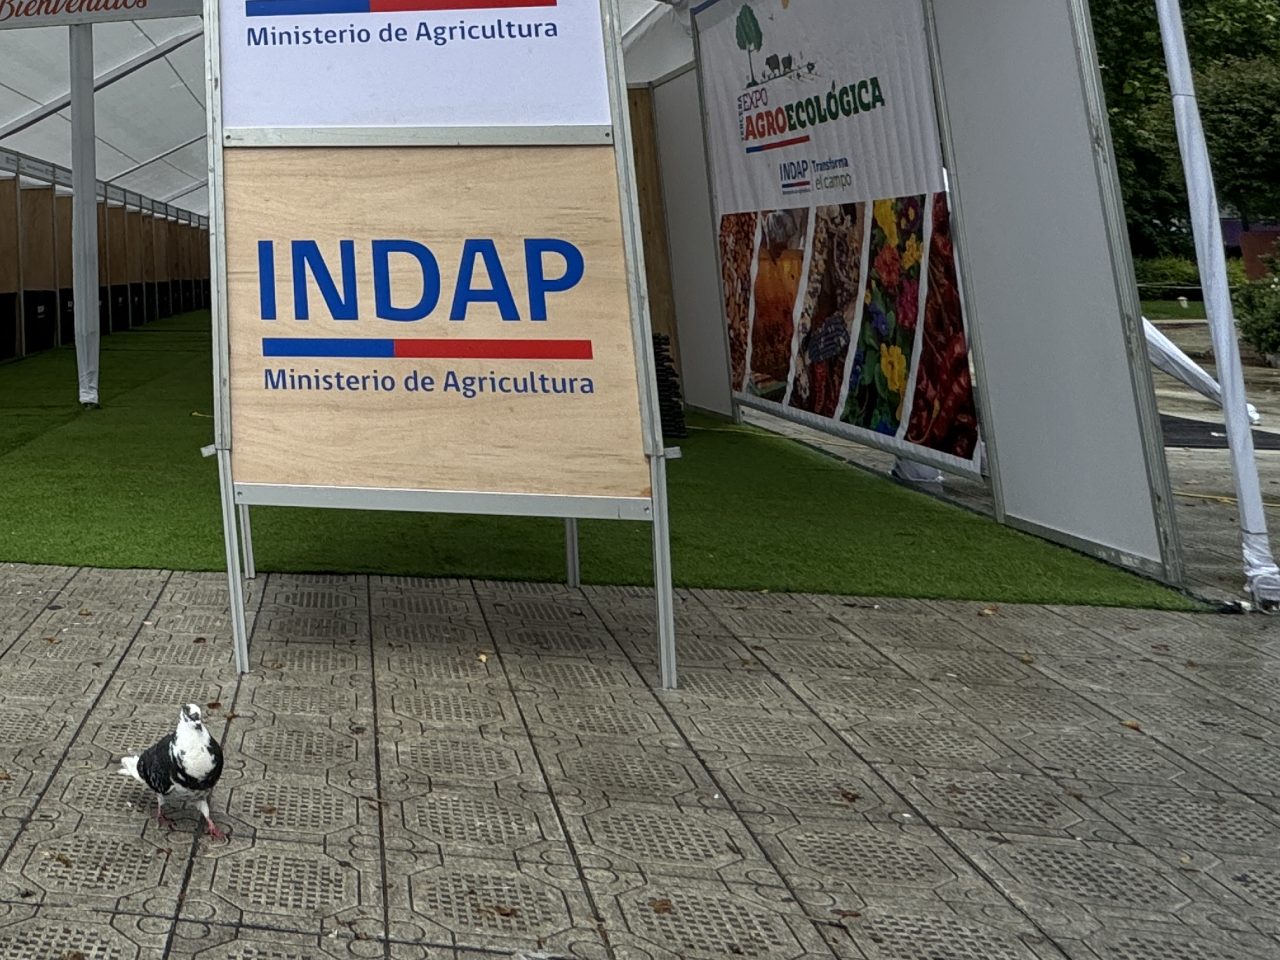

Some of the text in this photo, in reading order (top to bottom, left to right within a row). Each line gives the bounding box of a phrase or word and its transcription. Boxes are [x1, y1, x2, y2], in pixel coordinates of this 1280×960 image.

[246, 19, 559, 46] Ministerio de Agricultura
[742, 87, 768, 111] EXPO
[744, 76, 886, 141] AGROECOLÓGICA
[779, 159, 809, 182] INDAP
[811, 156, 849, 173] Transforma
[815, 172, 852, 192] el campo
[257, 238, 586, 322] INDAP
[263, 368, 596, 395] Ministerio de Agricultura
